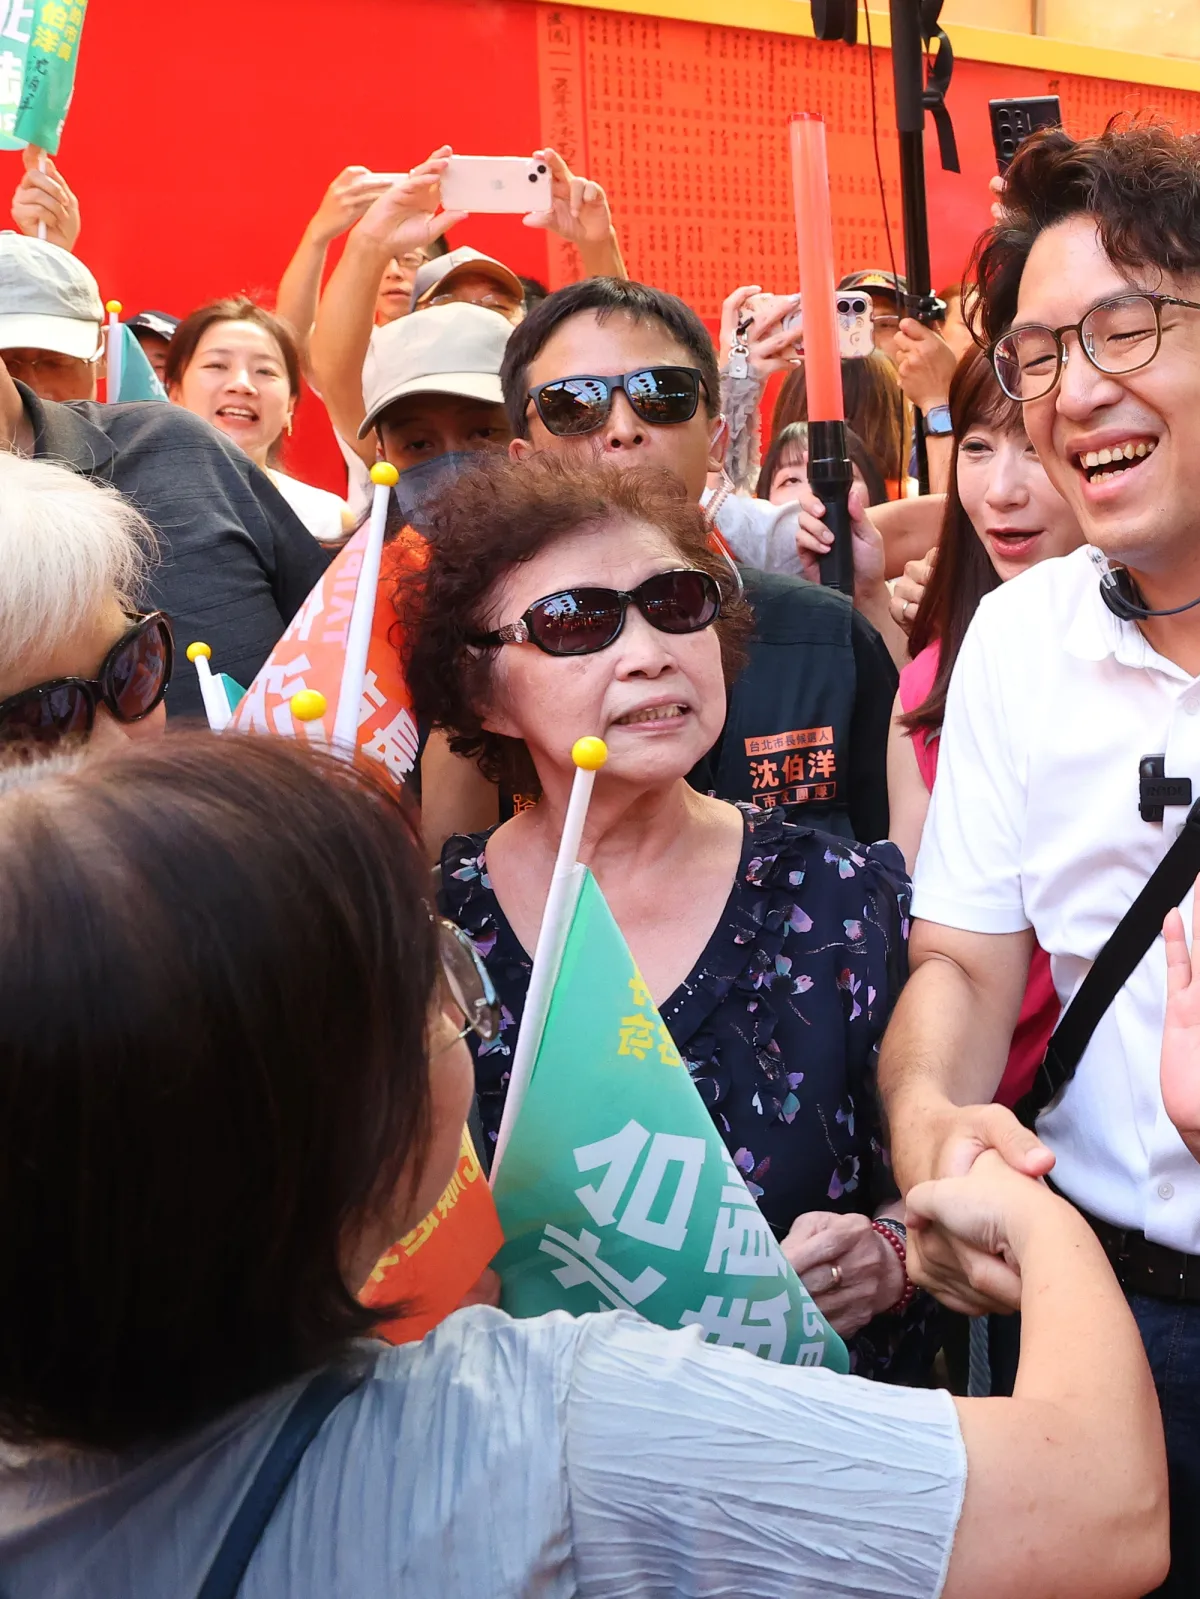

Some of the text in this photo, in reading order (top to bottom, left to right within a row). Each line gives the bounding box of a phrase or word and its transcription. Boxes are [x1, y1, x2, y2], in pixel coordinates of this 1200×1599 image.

[749, 730, 829, 752] 台北市長候選人
[749, 749, 836, 789] 沈伯洋
